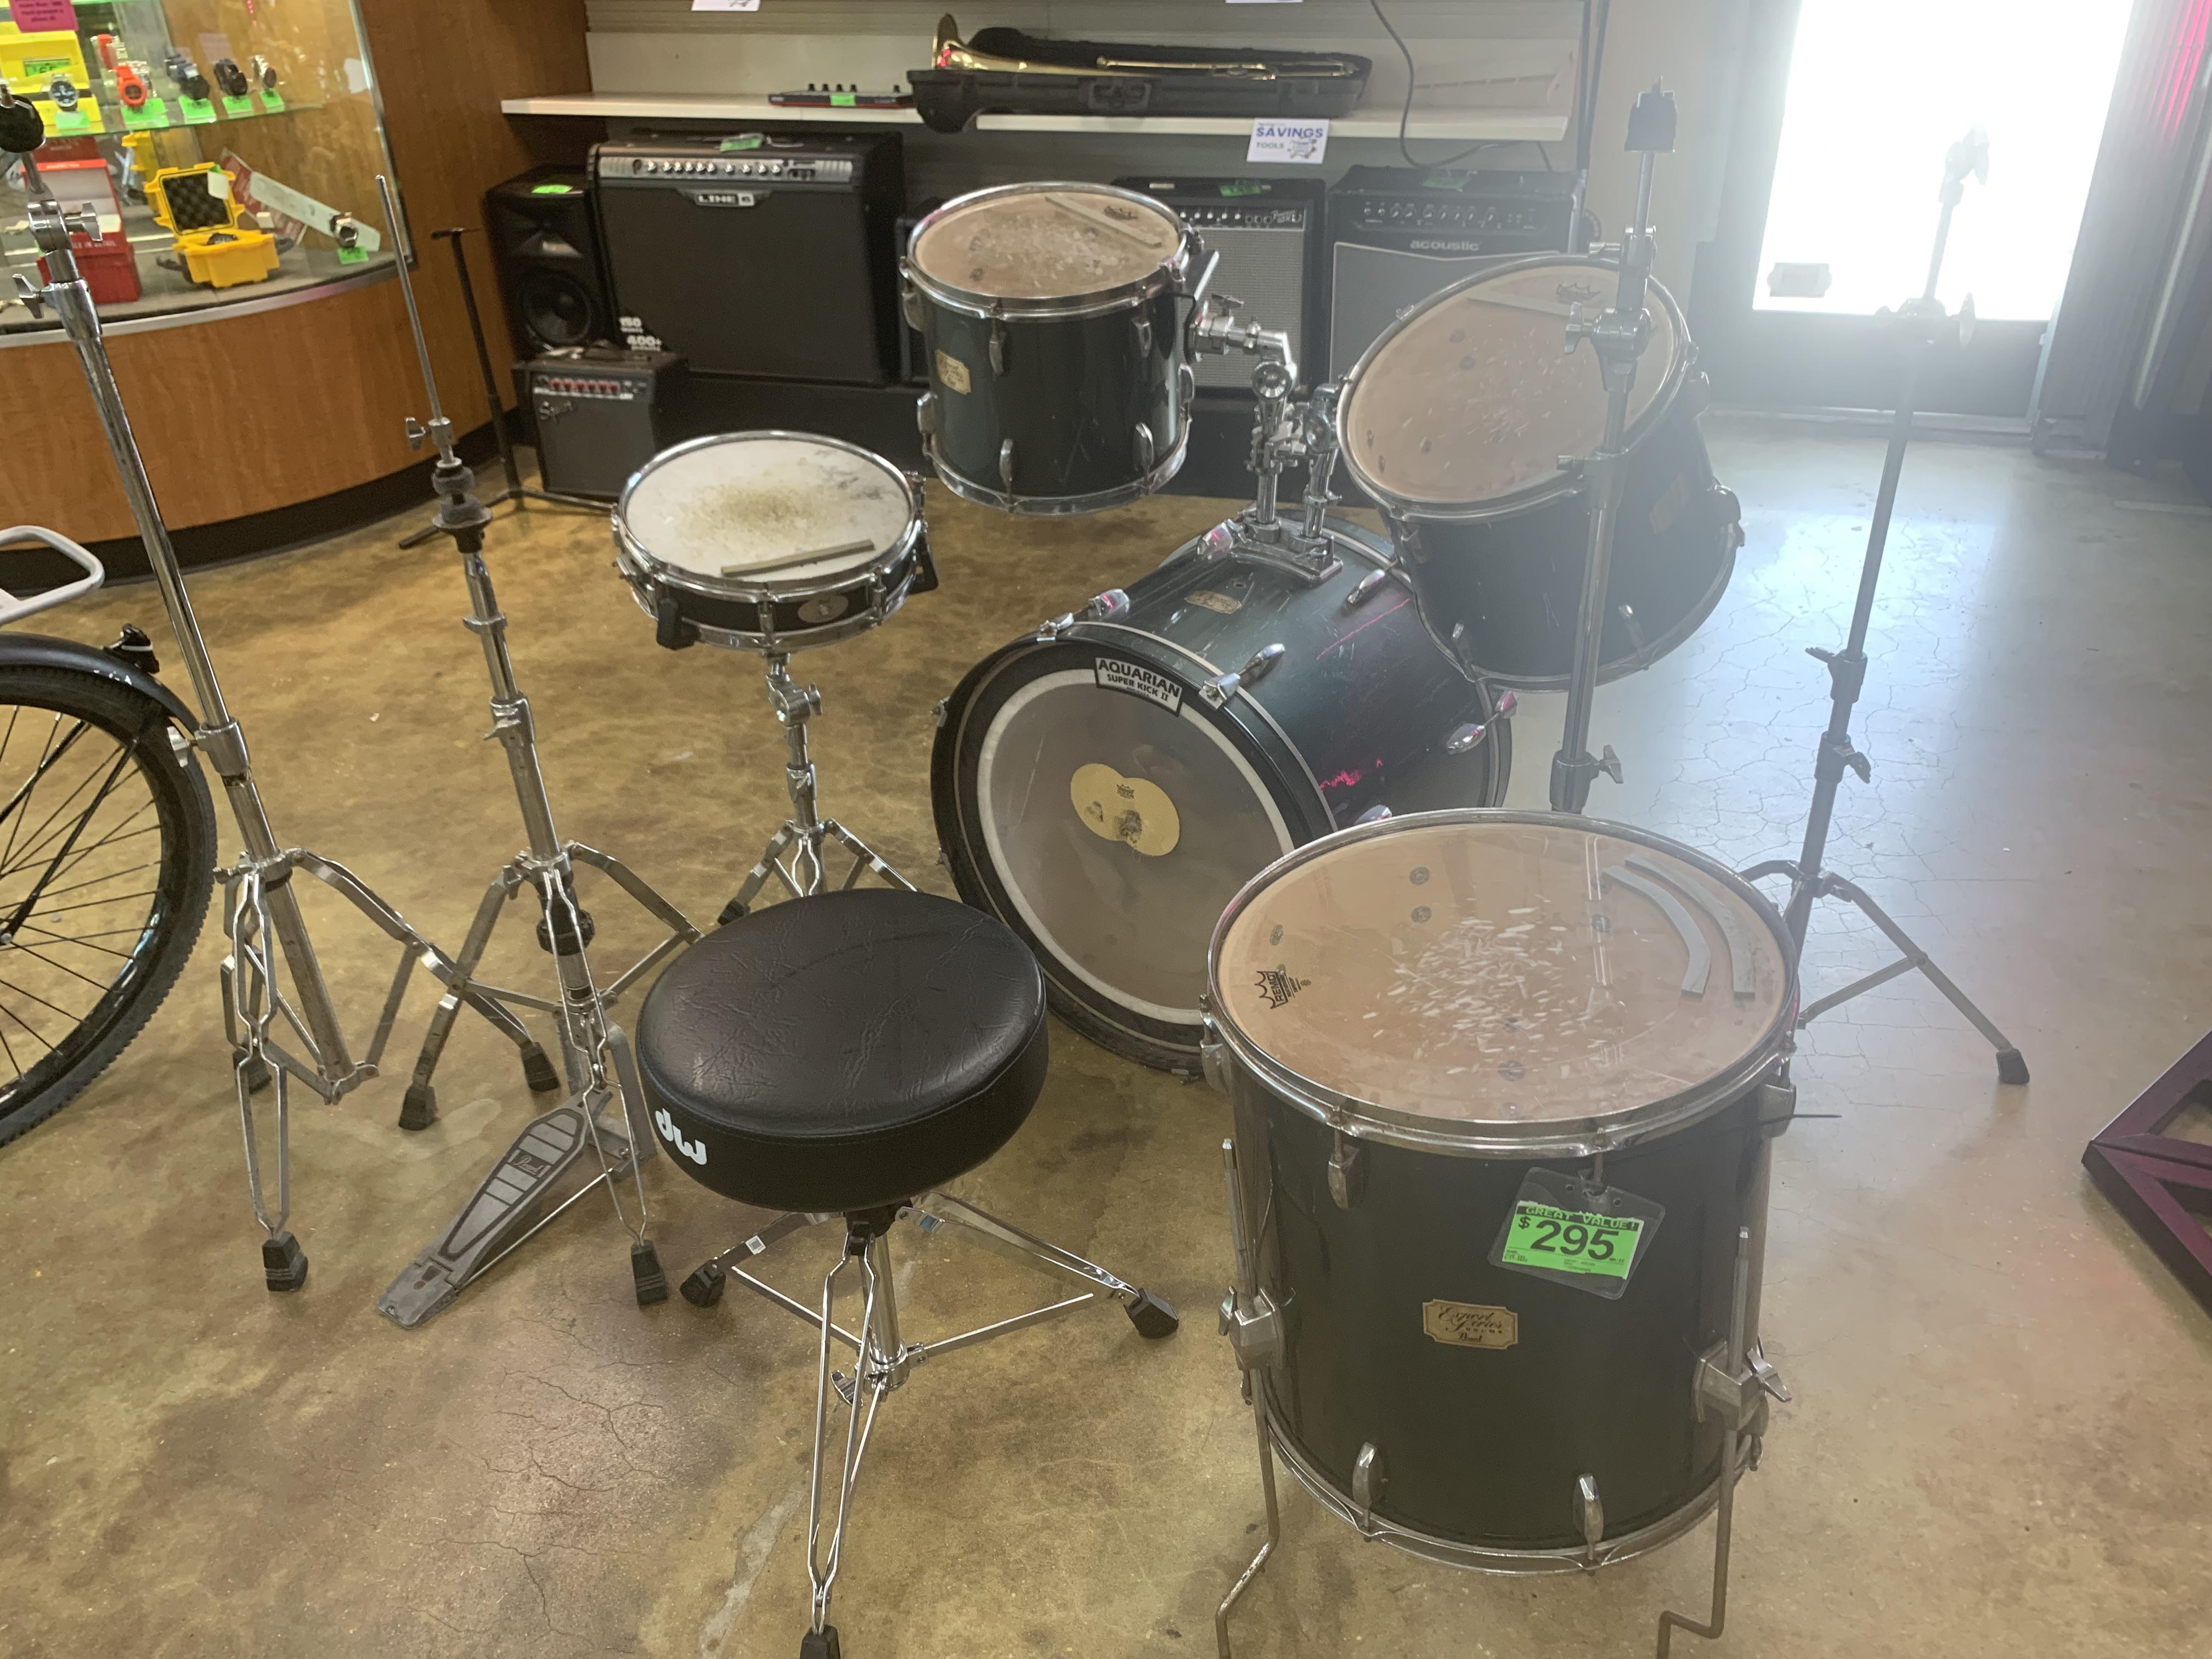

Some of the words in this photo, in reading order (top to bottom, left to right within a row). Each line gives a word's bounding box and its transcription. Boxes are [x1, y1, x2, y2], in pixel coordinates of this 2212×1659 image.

[1256, 127, 1324, 138] SAVINGS
[1410, 240, 1480, 251] acoustic
[1098, 659, 1180, 698] AQUARIAN
[1107, 674, 1135, 687] SUPER
[1137, 682, 1159, 697] KICK
[1266, 974, 1284, 1002] REMO
[655, 1108, 707, 1165] dw
[1525, 1207, 1571, 1221] GREAT
[1583, 1214, 1635, 1231] VALUE!
[1530, 1220, 1619, 1260] 295
